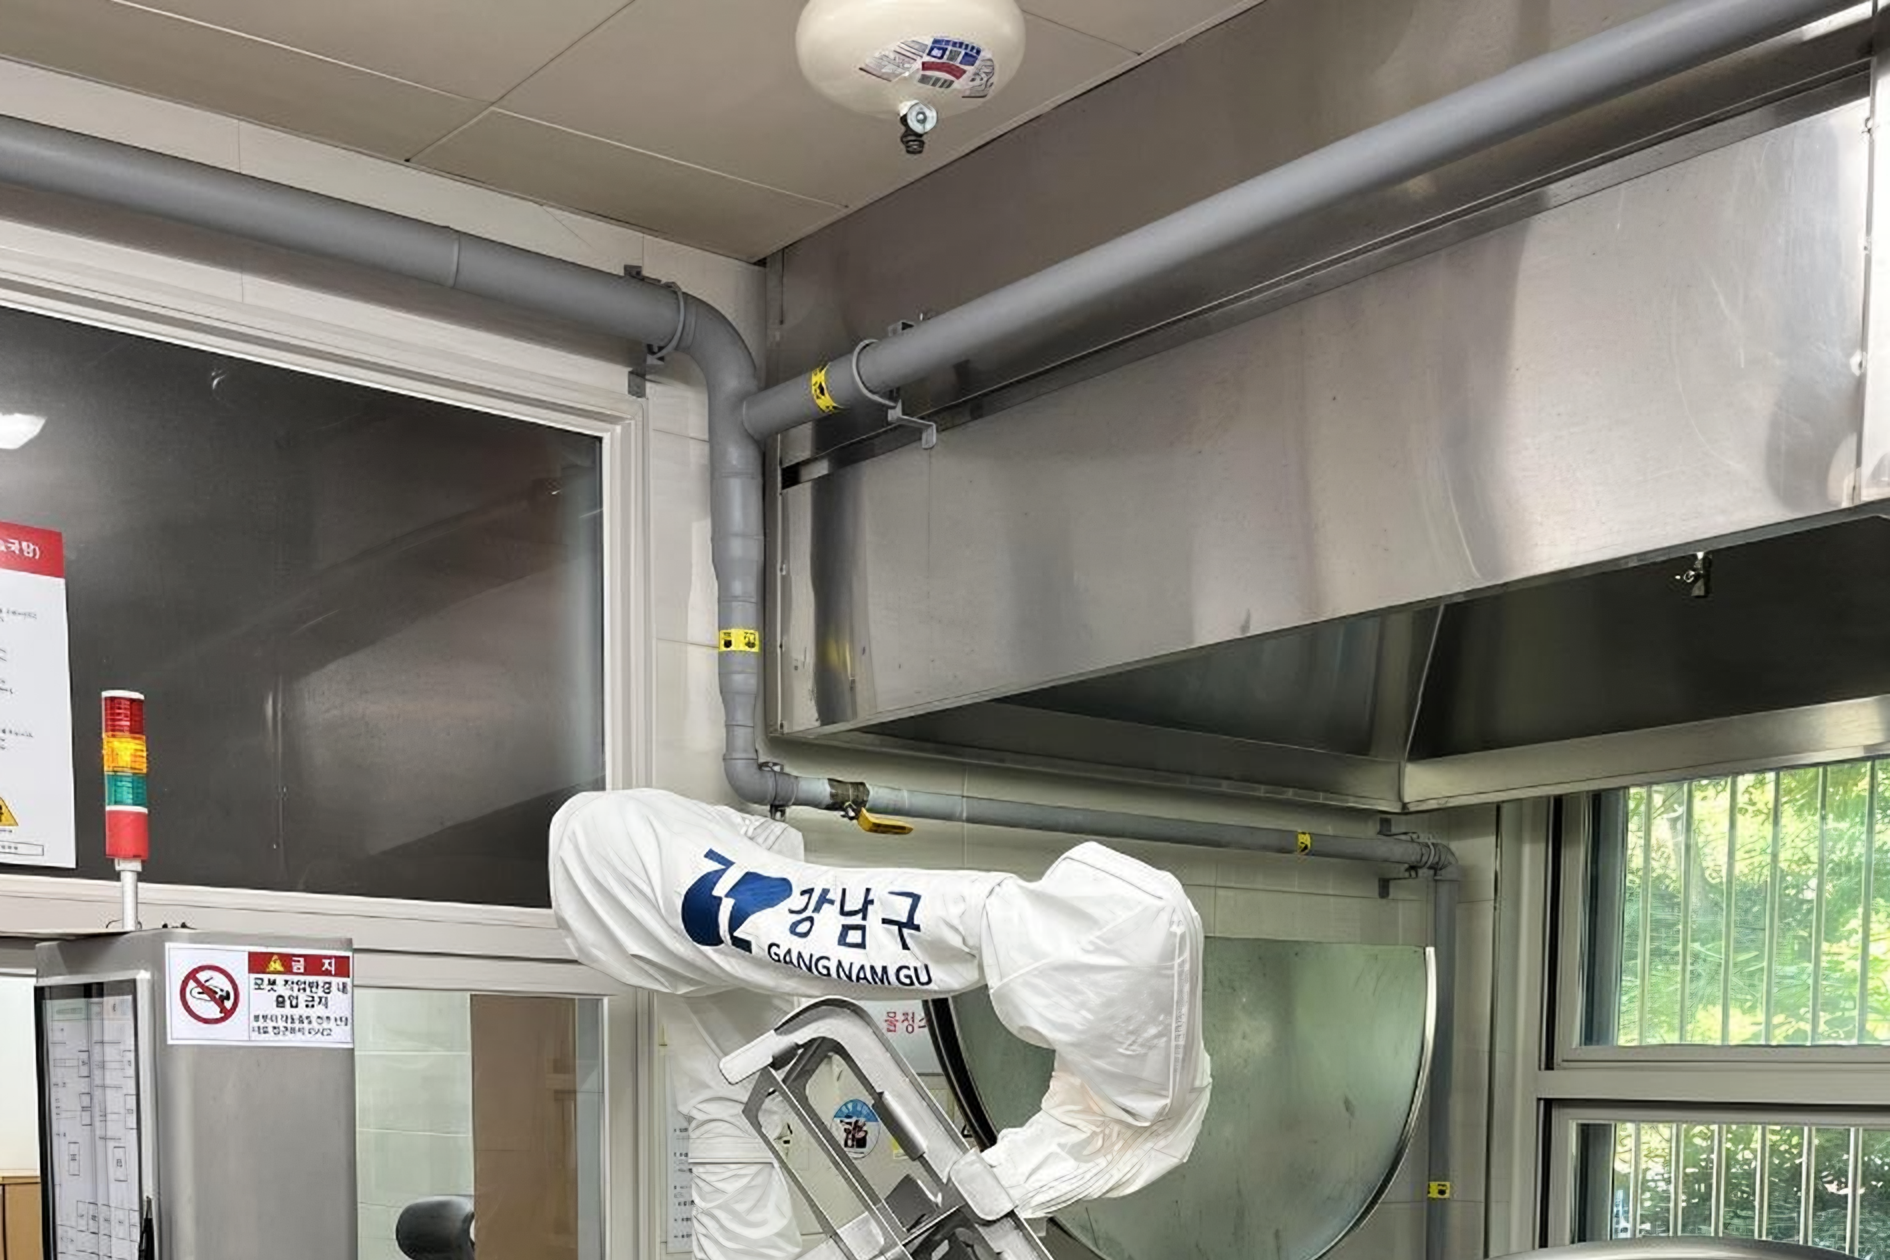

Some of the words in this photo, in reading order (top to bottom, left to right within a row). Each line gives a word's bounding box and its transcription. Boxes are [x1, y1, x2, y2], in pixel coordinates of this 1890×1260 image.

[788, 887, 922, 951] 강남구
[895, 963, 933, 987] GU
[304, 995, 329, 1010] 금지
